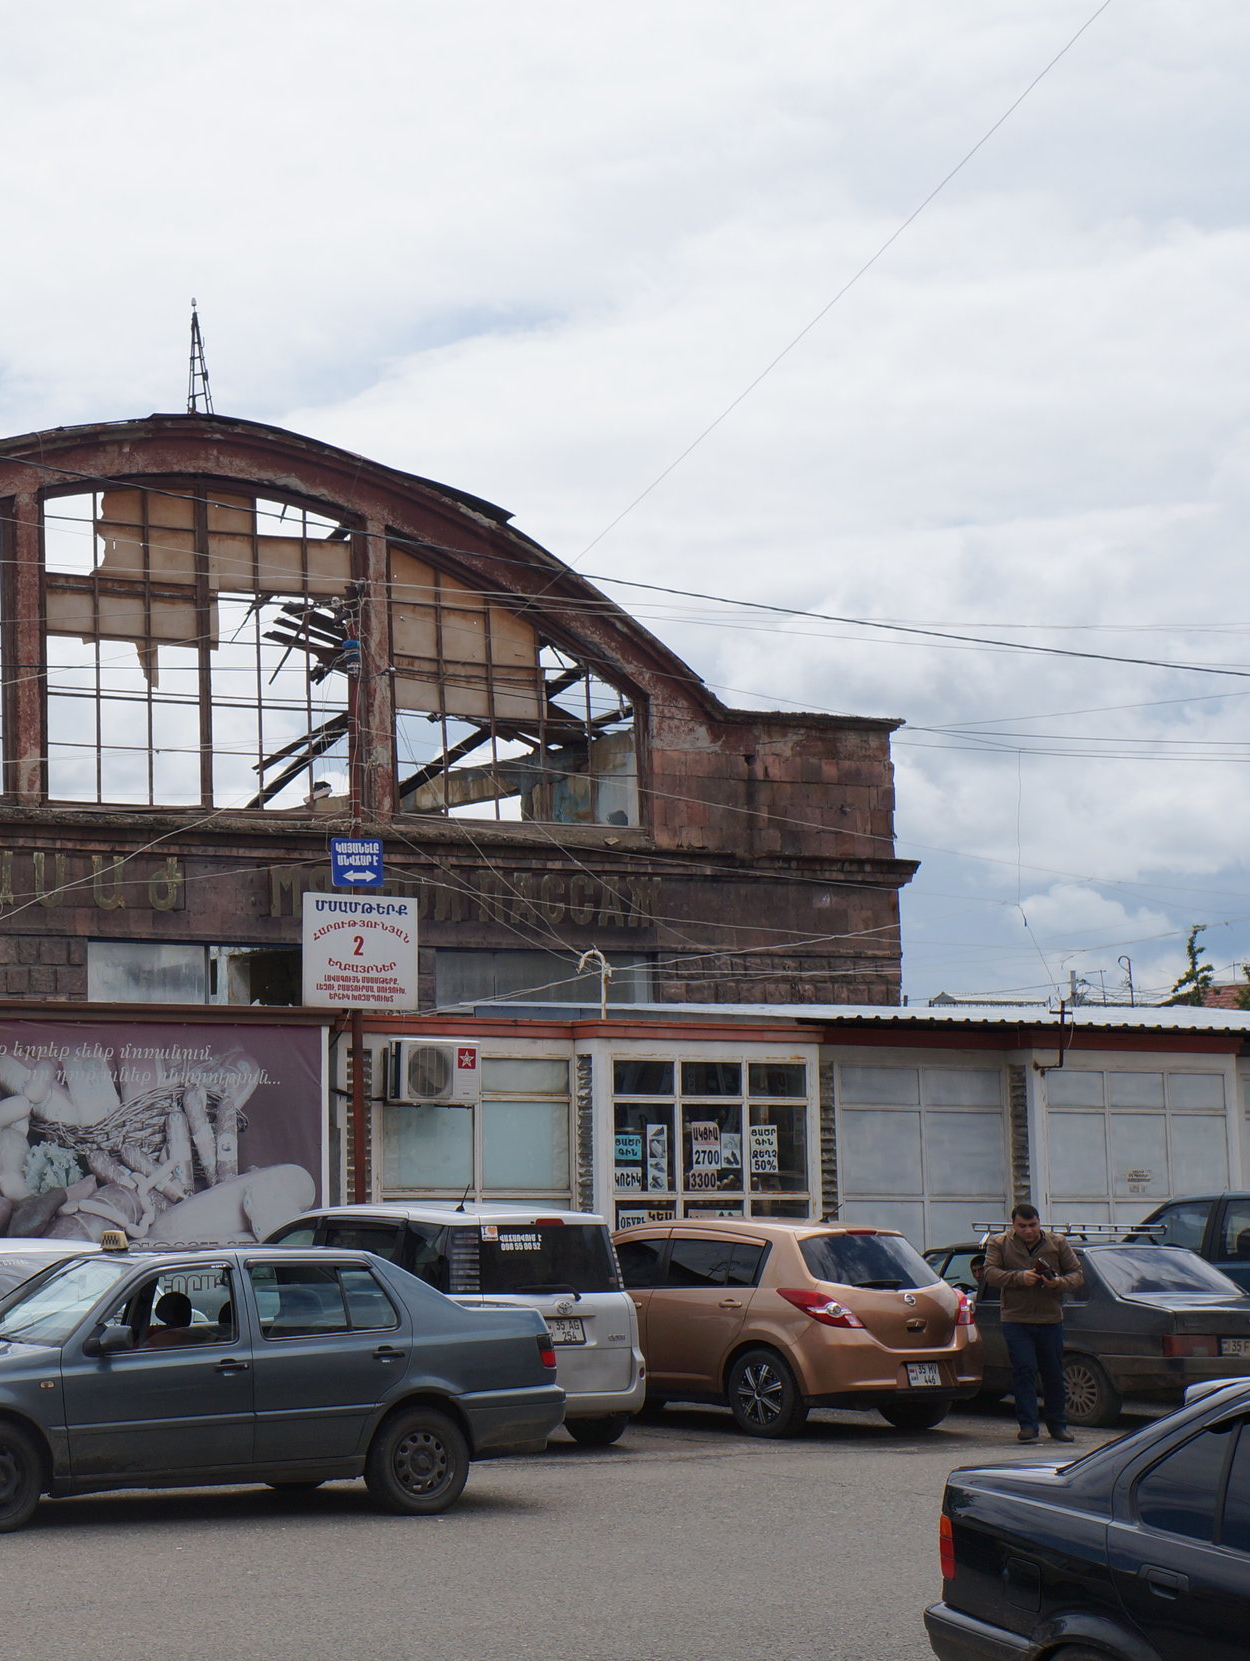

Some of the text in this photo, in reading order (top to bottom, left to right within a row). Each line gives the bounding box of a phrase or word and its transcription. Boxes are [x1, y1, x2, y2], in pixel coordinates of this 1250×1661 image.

[335, 842, 380, 854] ԿԱՅԱՆԵԼԸ
[337, 854, 379, 866] ԱՆՎՃԱՐ Է
[477, 870, 662, 928] ПАССАЖ
[315, 899, 408, 916] ՄՍԱՄԹԵՐՔ
[312, 919, 410, 944] ՀԱՐՈՒԹՅՈՒՆՅԱՆ
[353, 935, 365, 957] 2
[327, 957, 398, 974] ԵՂԲԱՅՐՆԵՐ
[324, 974, 360, 984] ԼԱՎԱԳՈՒՅՆ
[14, 1041, 70, 1062] երբեք
[75, 1043, 114, 1063] չենք
[120, 1045, 214, 1062] մոռանում,
[693, 1126, 719, 1142] ԱԿՑԻԱ
[751, 1129, 776, 1138] ՑԱԾՐ
[615, 1137, 641, 1146] ՑԱԾՐ
[755, 1139, 774, 1147] ԳԻՆ
[618, 1148, 637, 1157] ԳԻՆ
[694, 1150, 720, 1167] 2700
[754, 1159, 777, 1172] 50%
[615, 1172, 642, 1188] ԿՈՇԻԿ
[691, 1172, 716, 1188] 3300
[501, 1243, 515, 1251] 098
[515, 1243, 524, 1251] 55
[554, 1320, 580, 1331] 35 AG
[562, 1331, 577, 1341] 254
[1231, 1340, 1241, 1352] 35
[918, 1364, 926, 1374] 35
